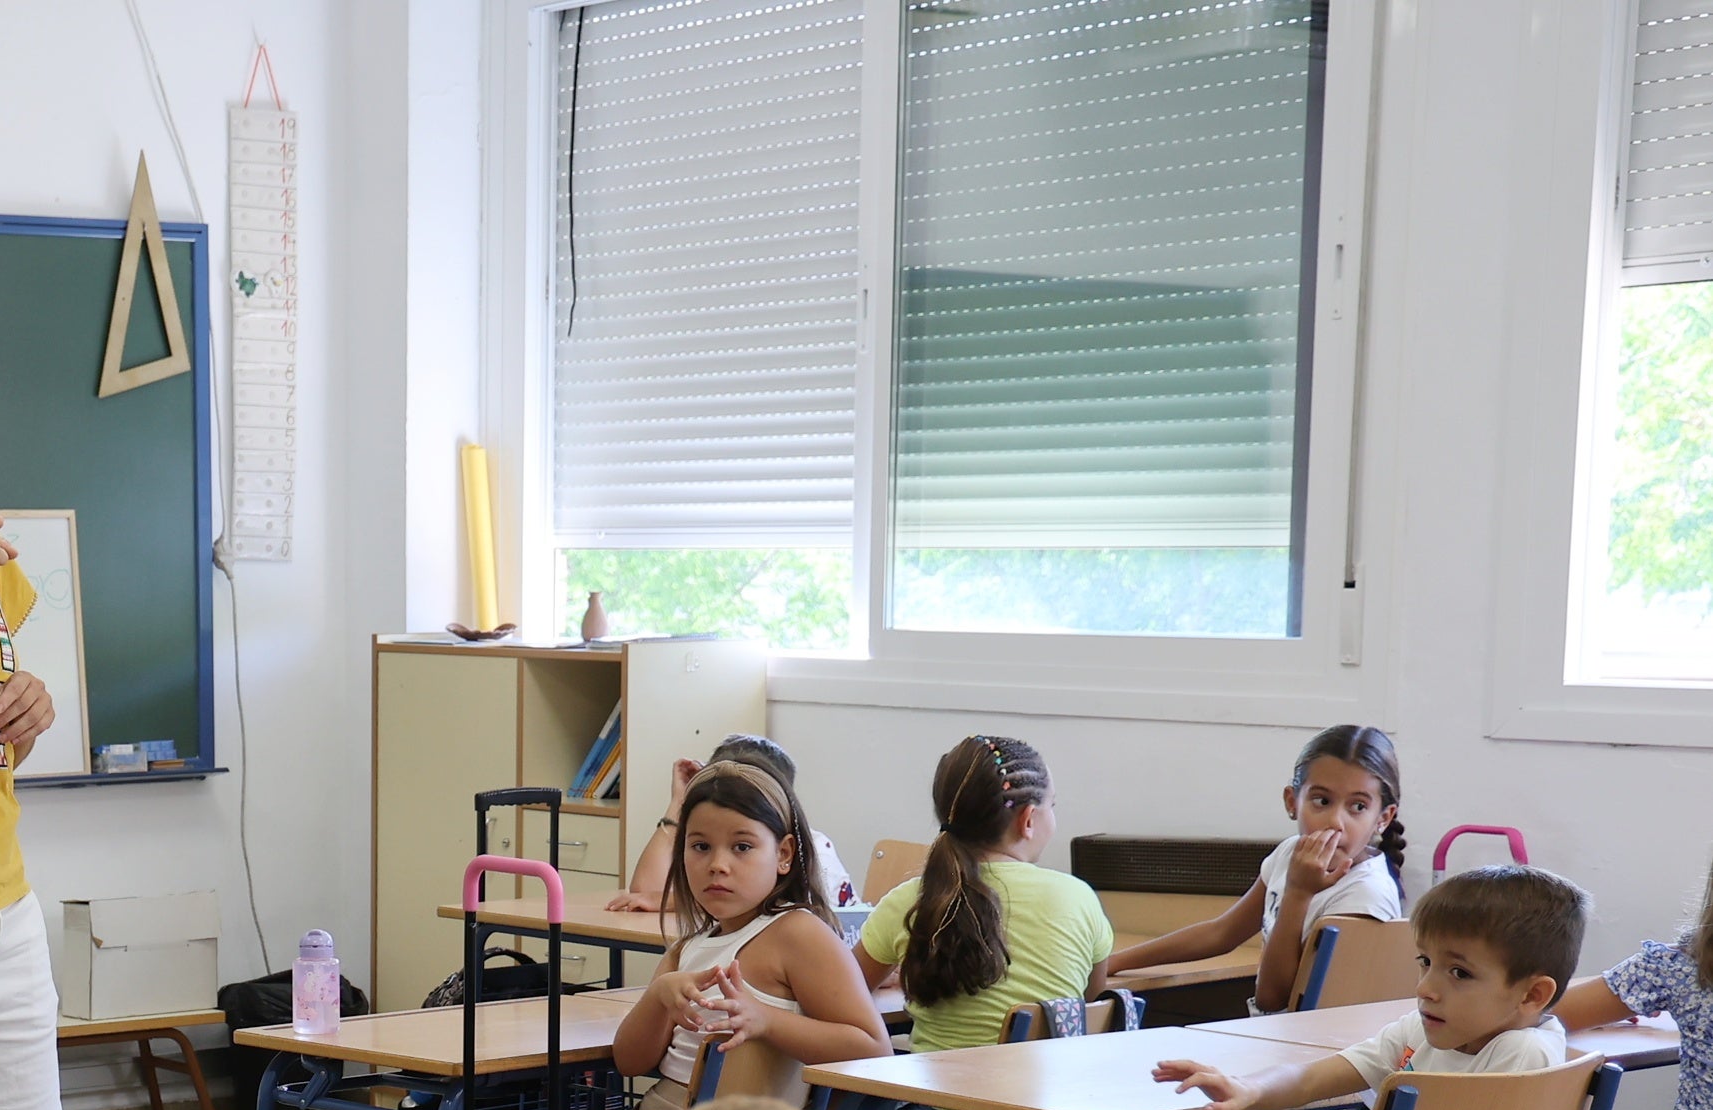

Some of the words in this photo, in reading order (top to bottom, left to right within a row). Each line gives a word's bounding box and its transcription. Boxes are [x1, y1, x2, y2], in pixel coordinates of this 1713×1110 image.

[279, 117, 296, 140] 19
[280, 142, 296, 161] 18
[280, 167, 295, 184] 17
[281, 319, 297, 338] 10
